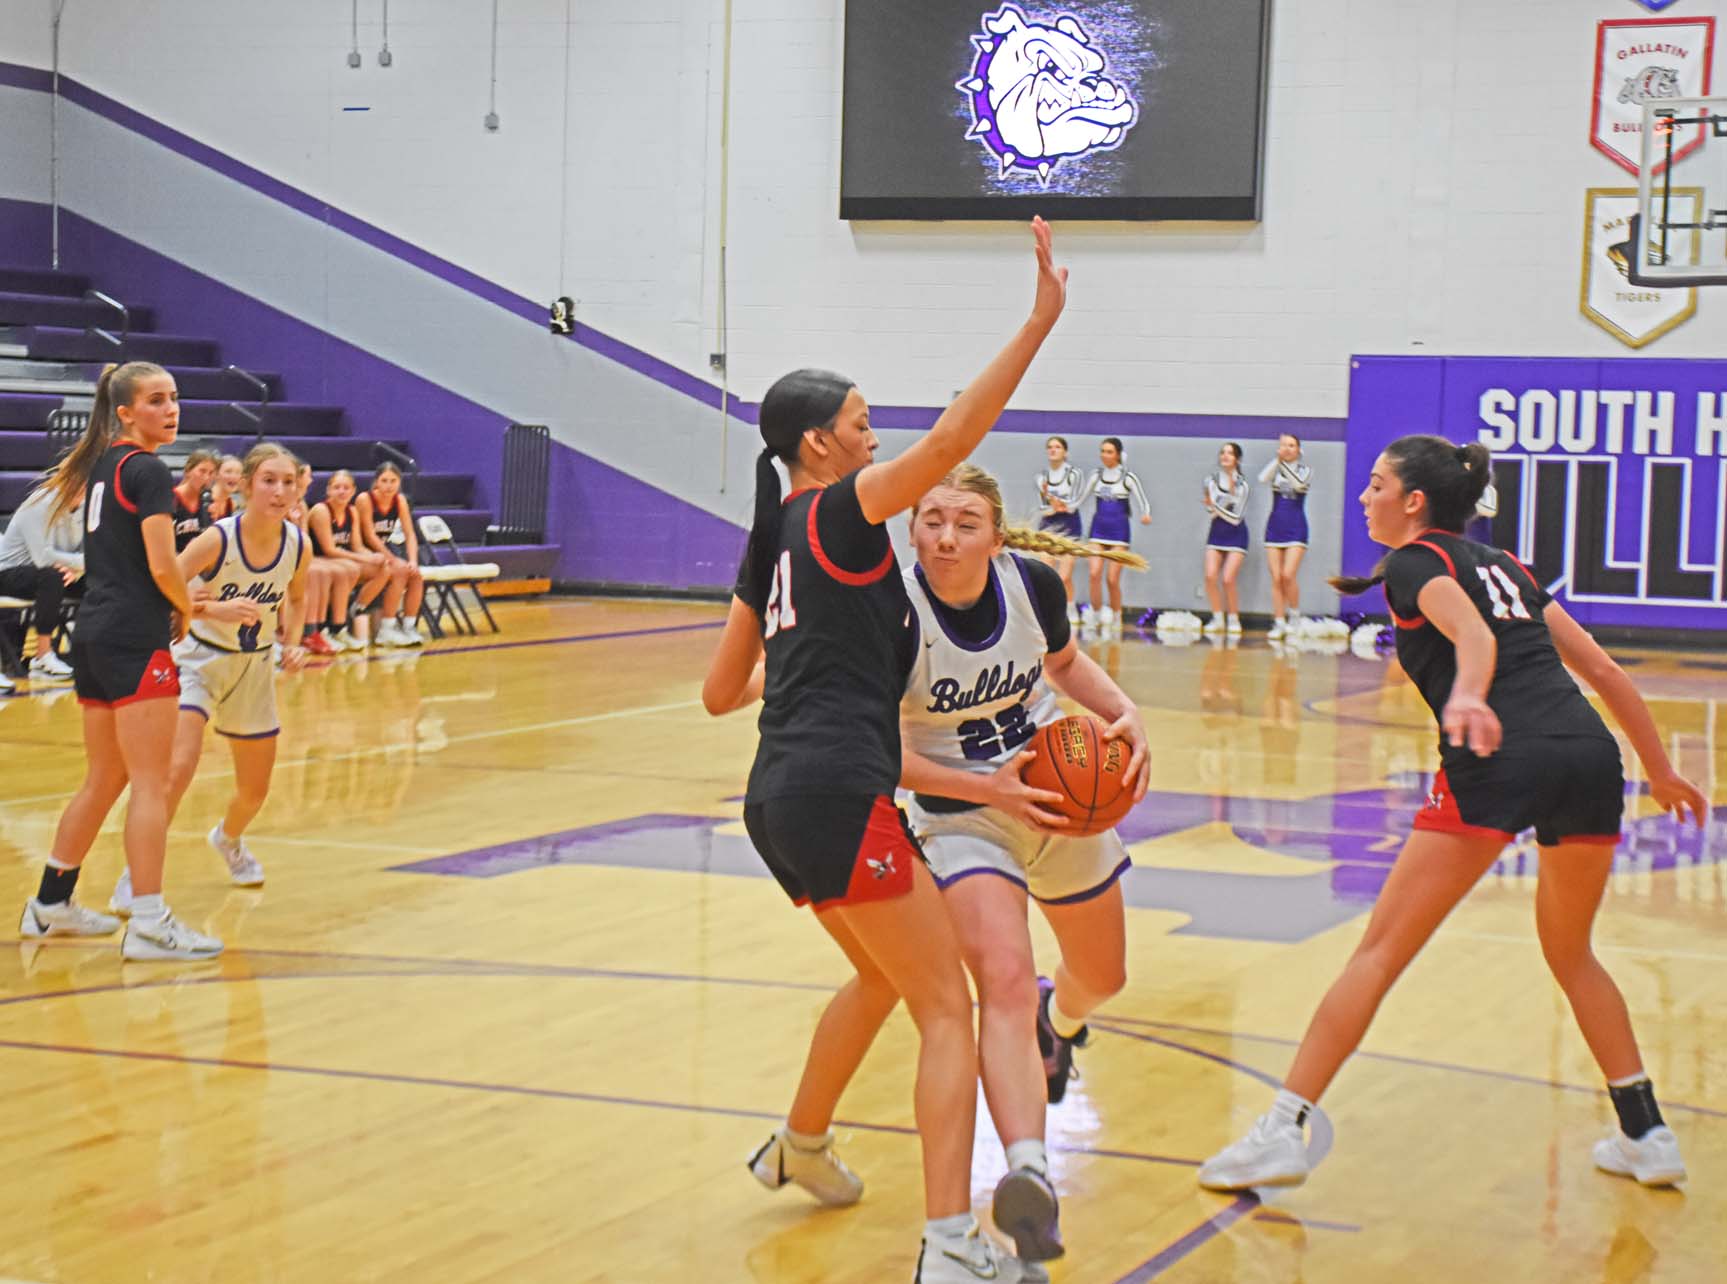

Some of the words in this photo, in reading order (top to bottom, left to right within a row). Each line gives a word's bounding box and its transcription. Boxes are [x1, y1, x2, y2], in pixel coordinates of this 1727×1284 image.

[1617, 43, 1688, 60] GALLATIN
[1615, 292, 1661, 303] TIGERS
[1478, 388, 1675, 455] SOUTH
[1475, 564, 1532, 620] 11
[957, 702, 1037, 762] 22
